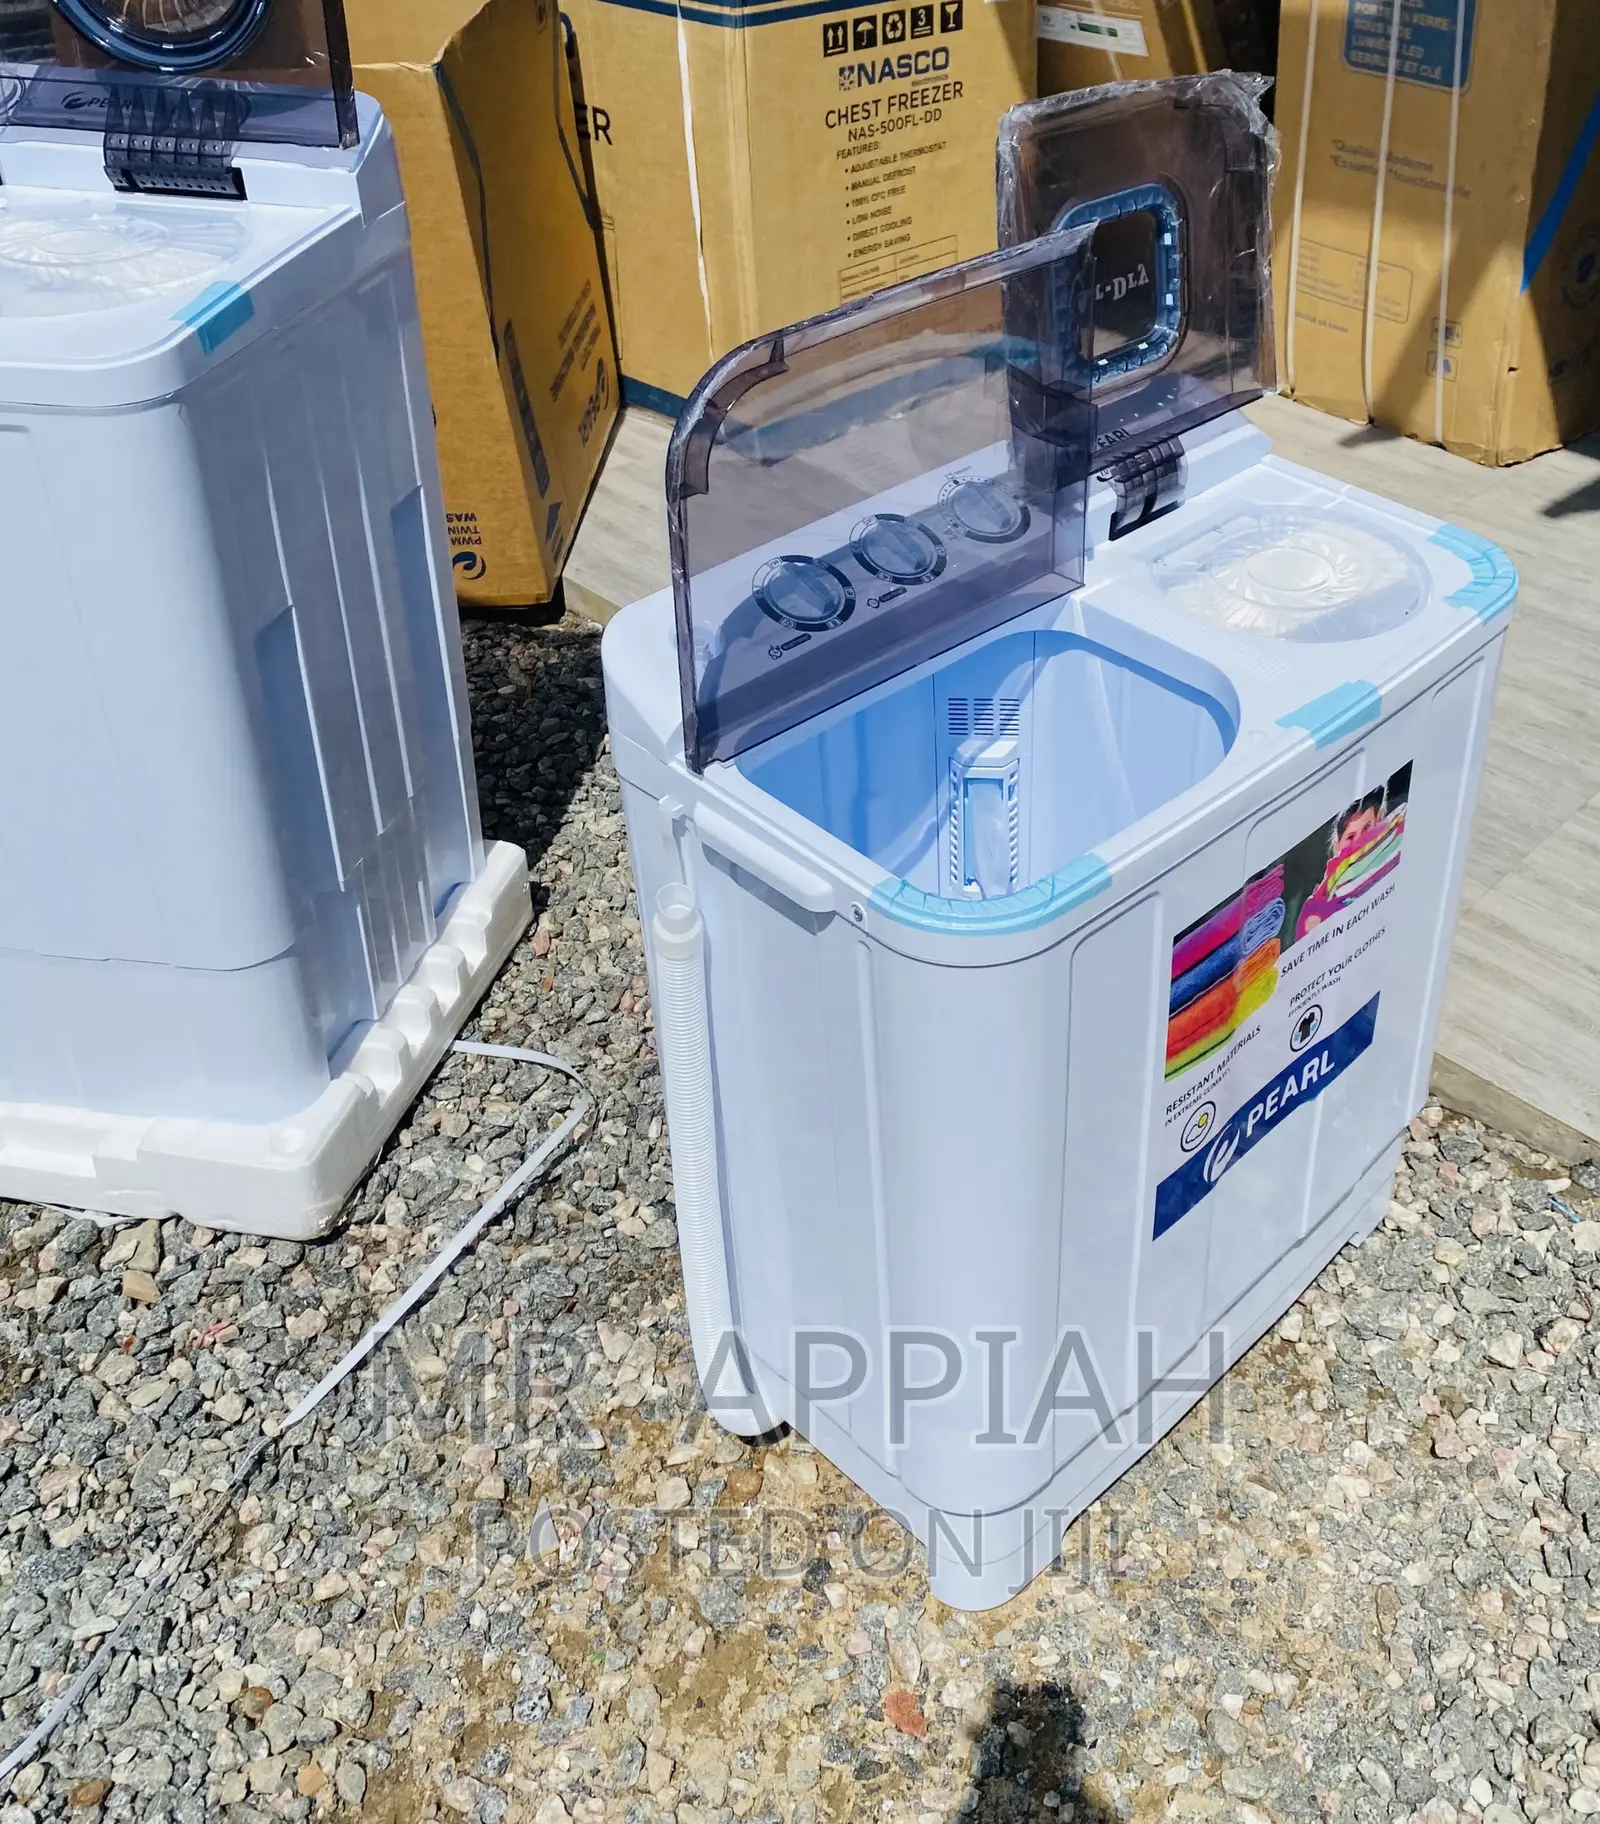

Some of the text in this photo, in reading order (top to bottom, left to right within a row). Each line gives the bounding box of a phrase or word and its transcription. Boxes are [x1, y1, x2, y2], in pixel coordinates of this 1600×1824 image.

[857, 46, 950, 87] NASCO
[825, 80, 963, 129] CHEST FREEZER
[848, 108, 942, 142] NAS-500FL-DD
[850, 141, 946, 174] ADJUSTABLE THERMOSTAT
[851, 165, 916, 191] MANUAL DEFROST
[887, 185, 906, 197] FREE
[870, 205, 892, 219] NOISE
[852, 216, 912, 241] DIRECT COOLING
[853, 234, 910, 258] ENERGY SAVING
[445, 513, 477, 523] WAS
[448, 525, 480, 535] TWIN
[451, 536, 482, 546] PWM
[1281, 883, 1396, 978] SAVE TIME IN EACH WASH
[1289, 926, 1386, 1007] PROTECT YOUR CLOTHES
[1321, 976, 1341, 991] WASH
[1166, 1024, 1261, 1116] RESISTANT MATERIALS
[1246, 1049, 1335, 1138] PEARL
[1173, 1094, 1202, 1121] EXTREME
